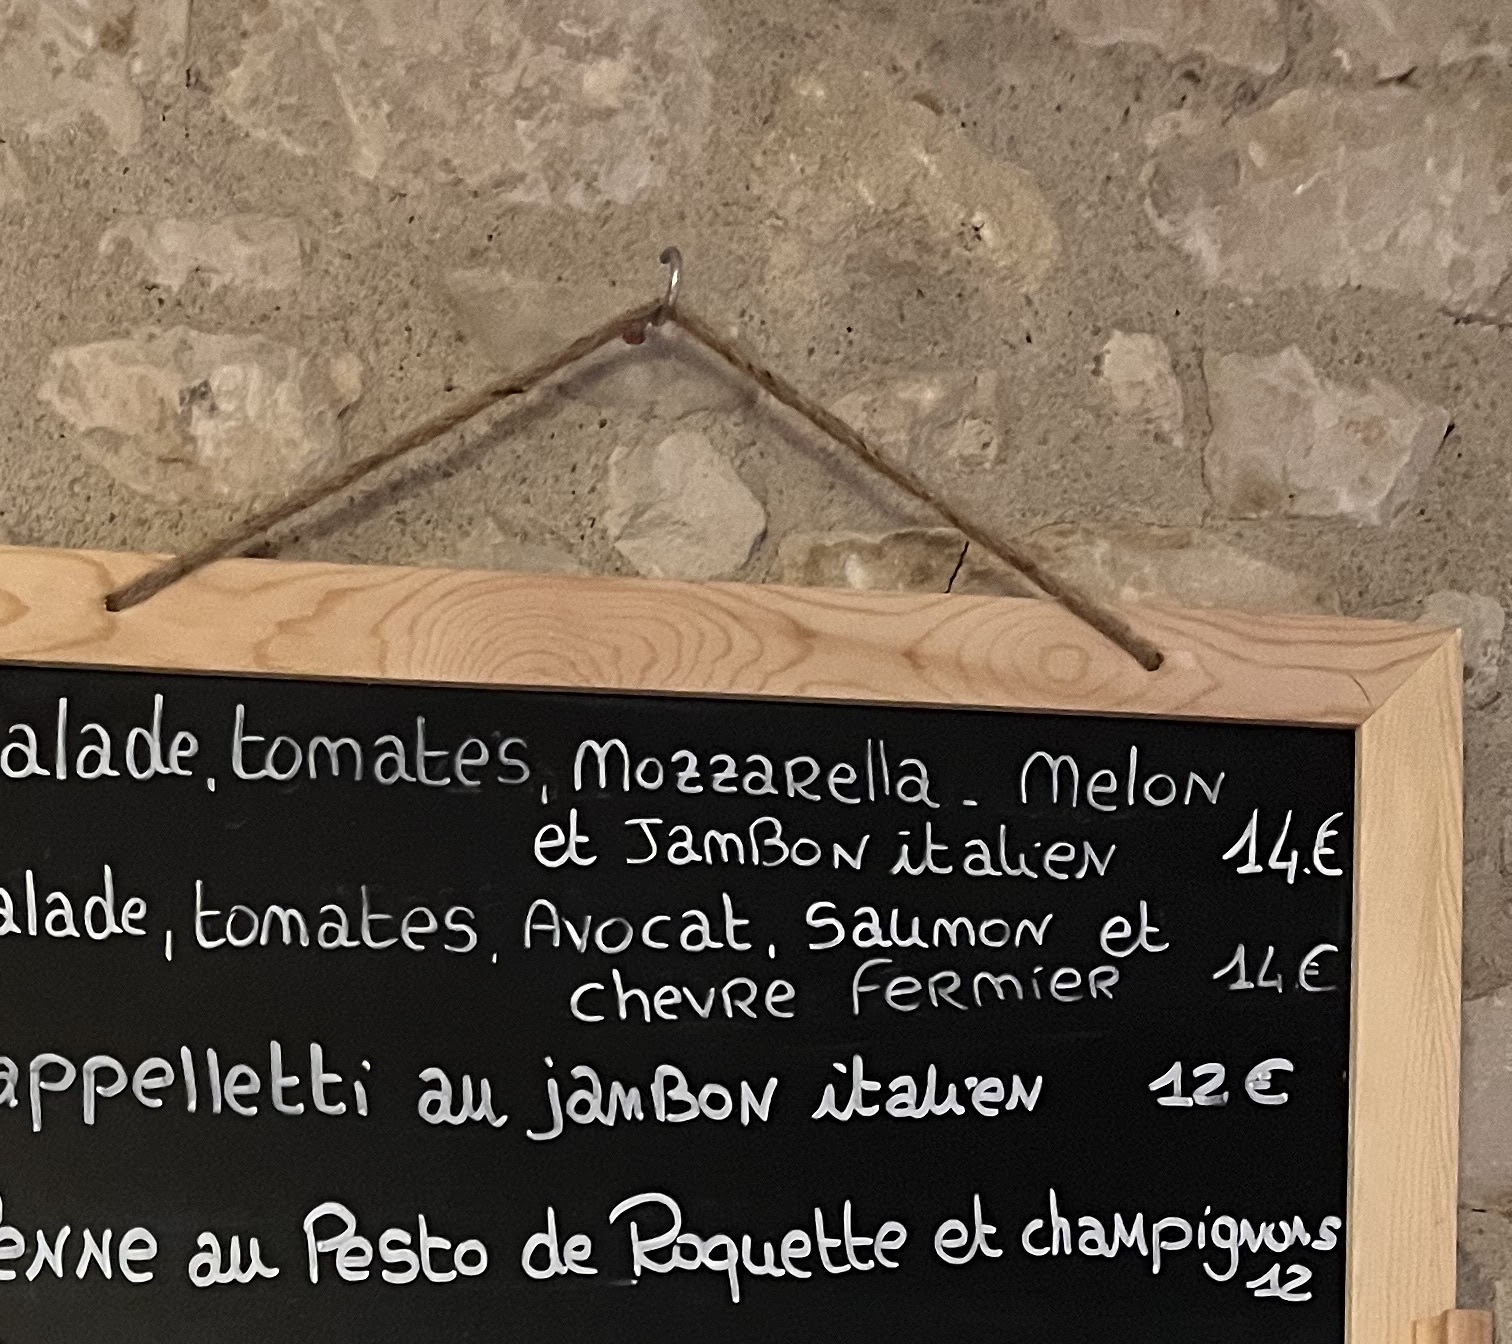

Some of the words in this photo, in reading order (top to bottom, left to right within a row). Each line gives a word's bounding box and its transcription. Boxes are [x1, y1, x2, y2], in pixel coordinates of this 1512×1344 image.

[532, 806, 599, 869] et
[1098, 898, 1171, 959] et
[416, 1065, 510, 1129] au
[187, 1230, 281, 1289] au
[301, 1200, 489, 1286] Pesto
[520, 1205, 600, 1281] de
[607, 1191, 909, 1305] Roquette
[932, 1192, 1005, 1266] et
[1244, 1261, 1314, 1303] 12
